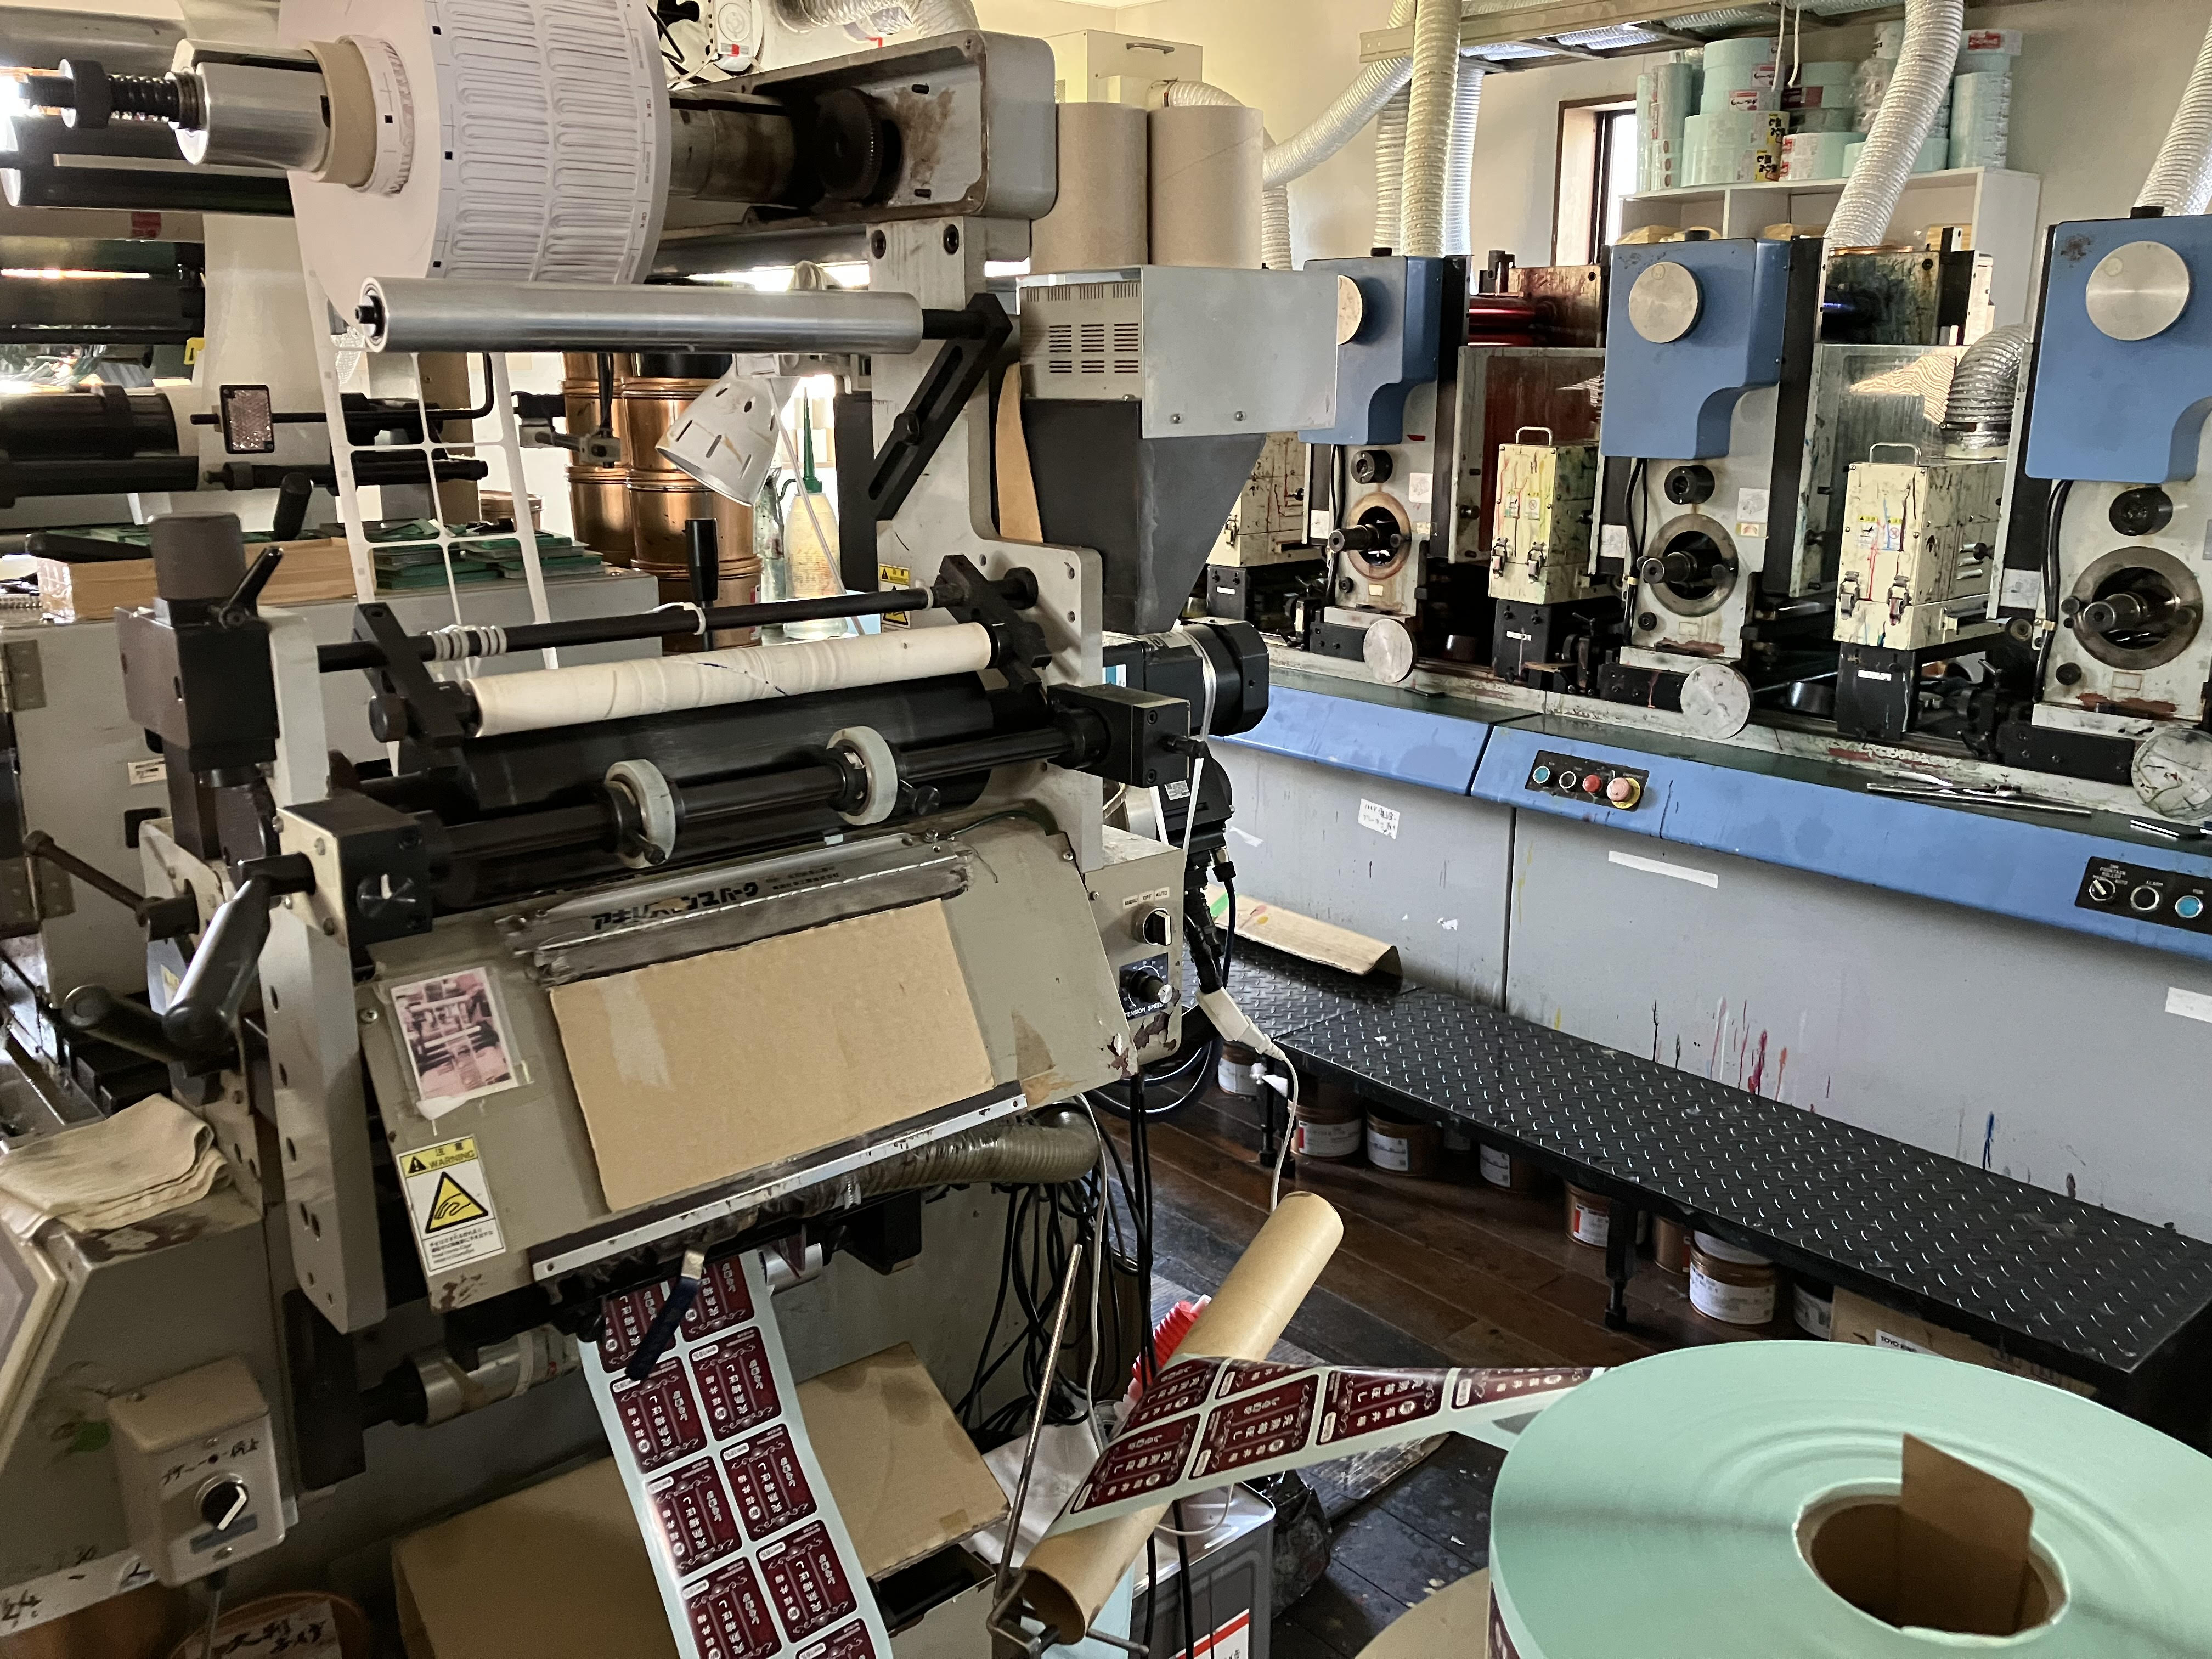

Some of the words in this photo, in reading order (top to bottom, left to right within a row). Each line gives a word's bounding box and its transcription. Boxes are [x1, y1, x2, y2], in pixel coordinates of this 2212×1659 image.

[1125, 1006, 1146, 1017] TENSION
[428, 1150, 475, 1169] WARNING
[1881, 1335, 1899, 1347] TOYO
